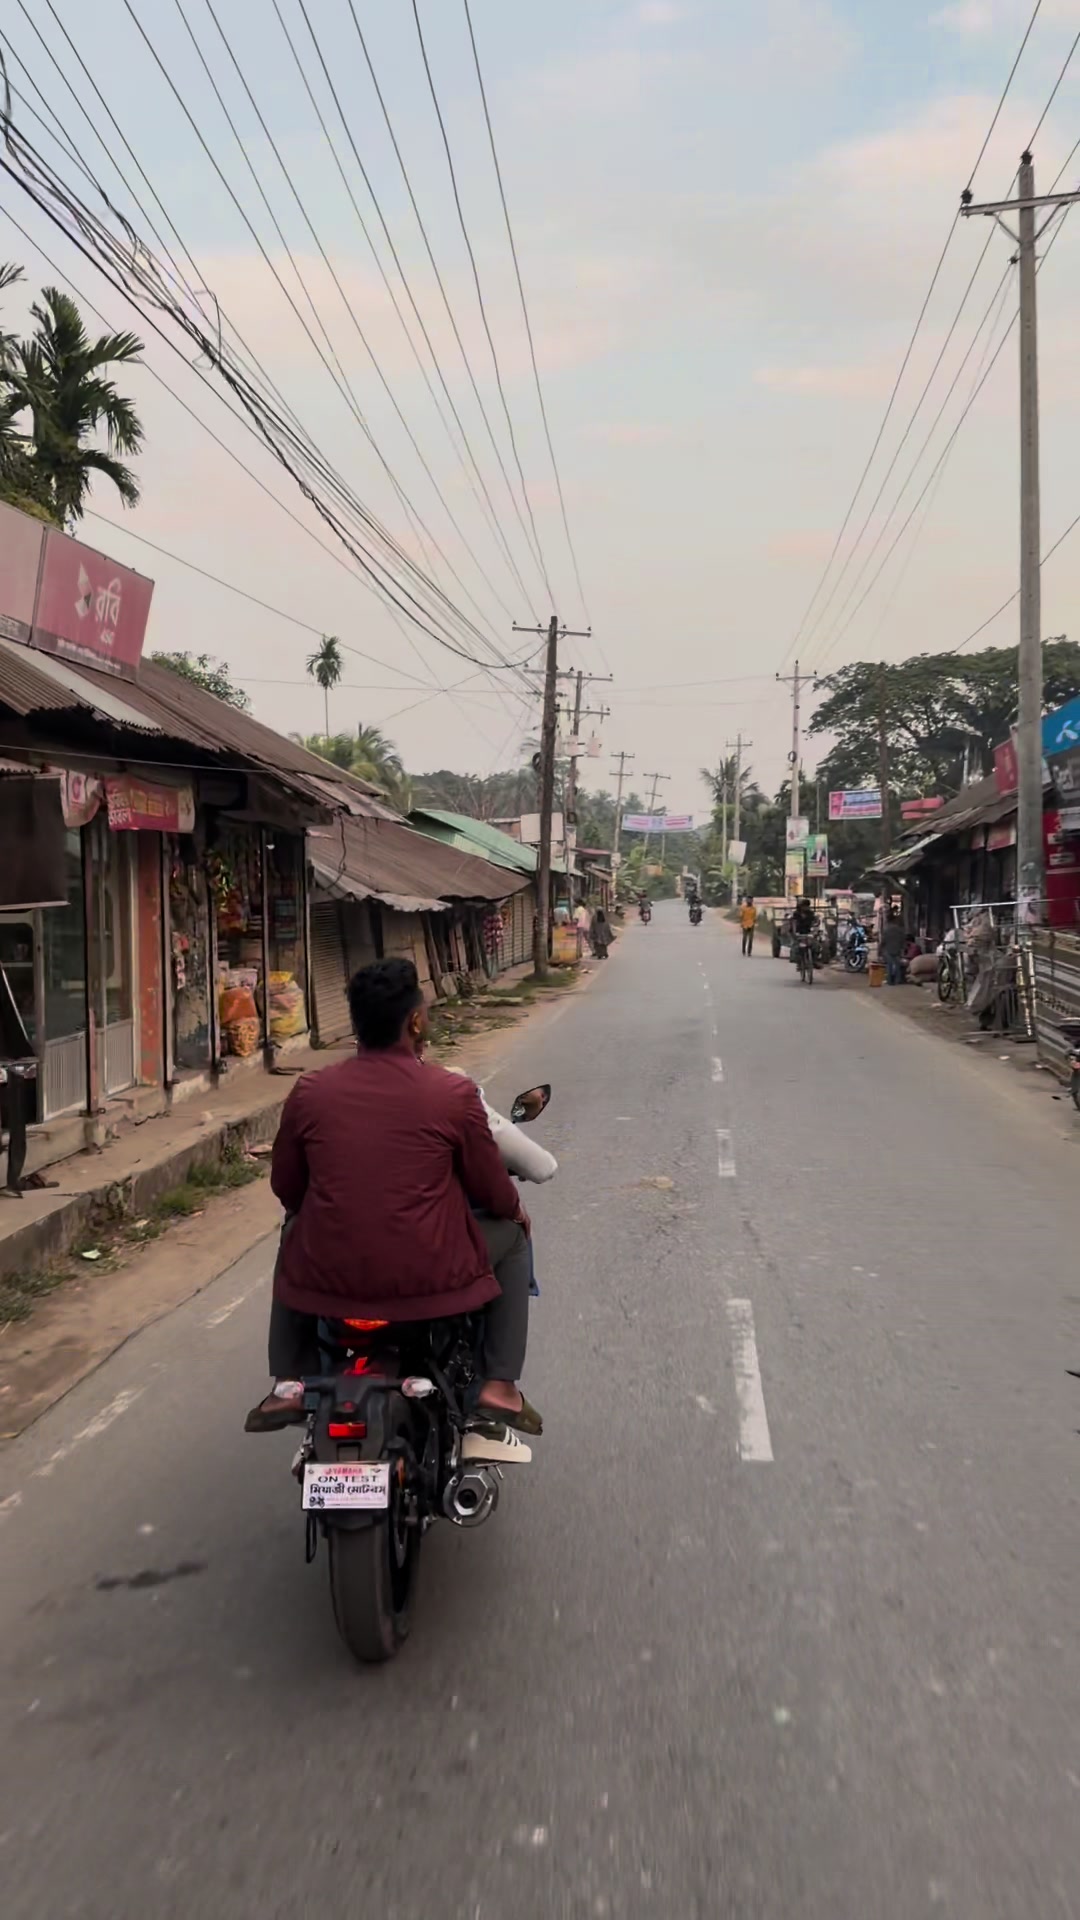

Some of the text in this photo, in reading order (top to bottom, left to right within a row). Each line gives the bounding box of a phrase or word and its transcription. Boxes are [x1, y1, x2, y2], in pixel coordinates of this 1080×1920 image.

[95, 577, 122, 627] রবি
[318, 1475, 377, 1483] ON TEST
